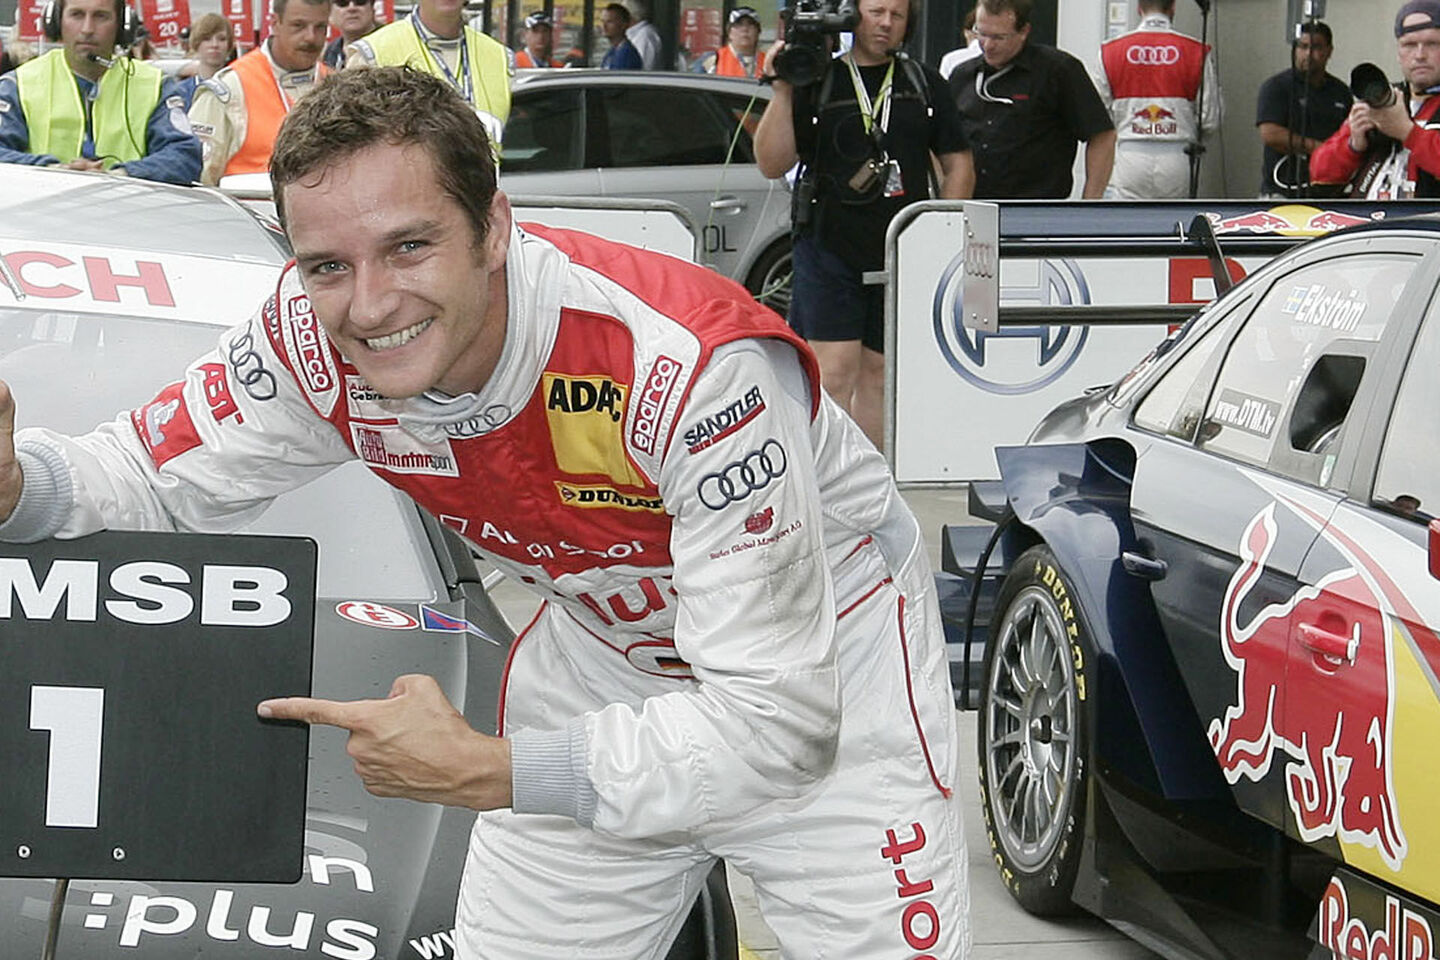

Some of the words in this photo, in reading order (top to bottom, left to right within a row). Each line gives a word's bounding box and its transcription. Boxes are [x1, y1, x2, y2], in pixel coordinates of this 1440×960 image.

[1132, 123, 1152, 134] Red
[683, 385, 764, 448] SANDTLER
[1042, 565, 1086, 700] DUNLOP
[29, 685, 105, 828] 1
